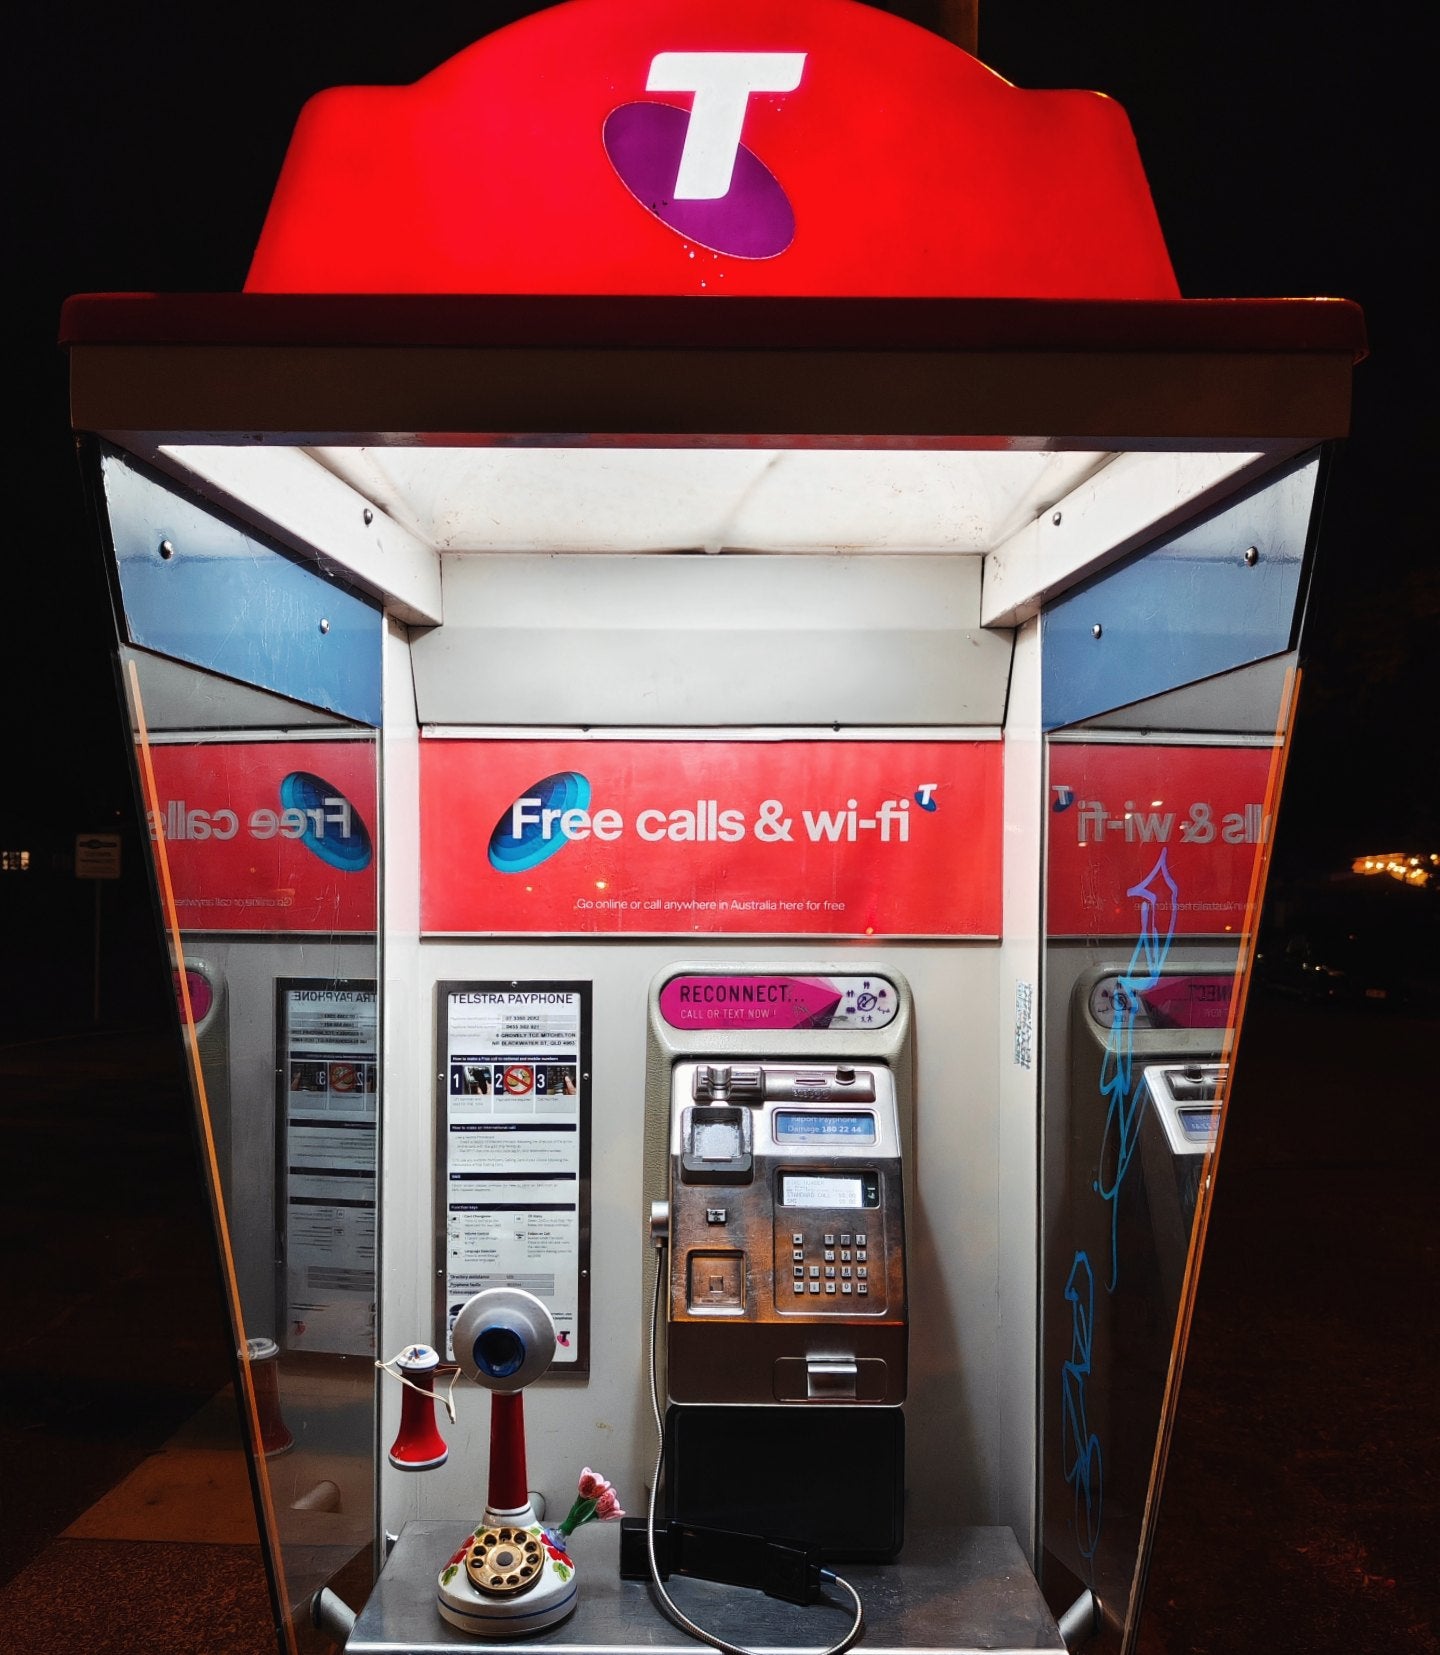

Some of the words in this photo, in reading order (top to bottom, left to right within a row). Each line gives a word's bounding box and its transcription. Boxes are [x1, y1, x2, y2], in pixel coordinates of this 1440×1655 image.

[645, 52, 808, 200] T
[918, 783, 938, 805] T
[512, 798, 623, 841] Free
[636, 800, 746, 842] calls
[754, 799, 794, 842] &
[802, 798, 910, 842] wi-fi
[577, 898, 594, 910] Go
[595, 898, 628, 910] online
[631, 900, 642, 910] or
[643, 898, 662, 910] call
[664, 899, 717, 912] anywhere
[719, 900, 729, 910] in
[730, 900, 777, 911] Australia
[779, 900, 804, 911] here
[806, 900, 821, 911] for
[823, 900, 846, 912] free
[452, 993, 504, 1004] TELSTRA
[508, 993, 573, 1004] PAYPHONE
[680, 985, 805, 1002] RECONNECT...
[680, 1010, 704, 1019] CALL
[707, 1010, 720, 1019] OR
[724, 1009, 744, 1019] TEXT
[748, 1009, 769, 1018] NOW
[453, 1074, 459, 1088] 1
[496, 1074, 503, 1088] 2
[537, 1074, 545, 1088] 3
[560, 1331, 570, 1342] T
